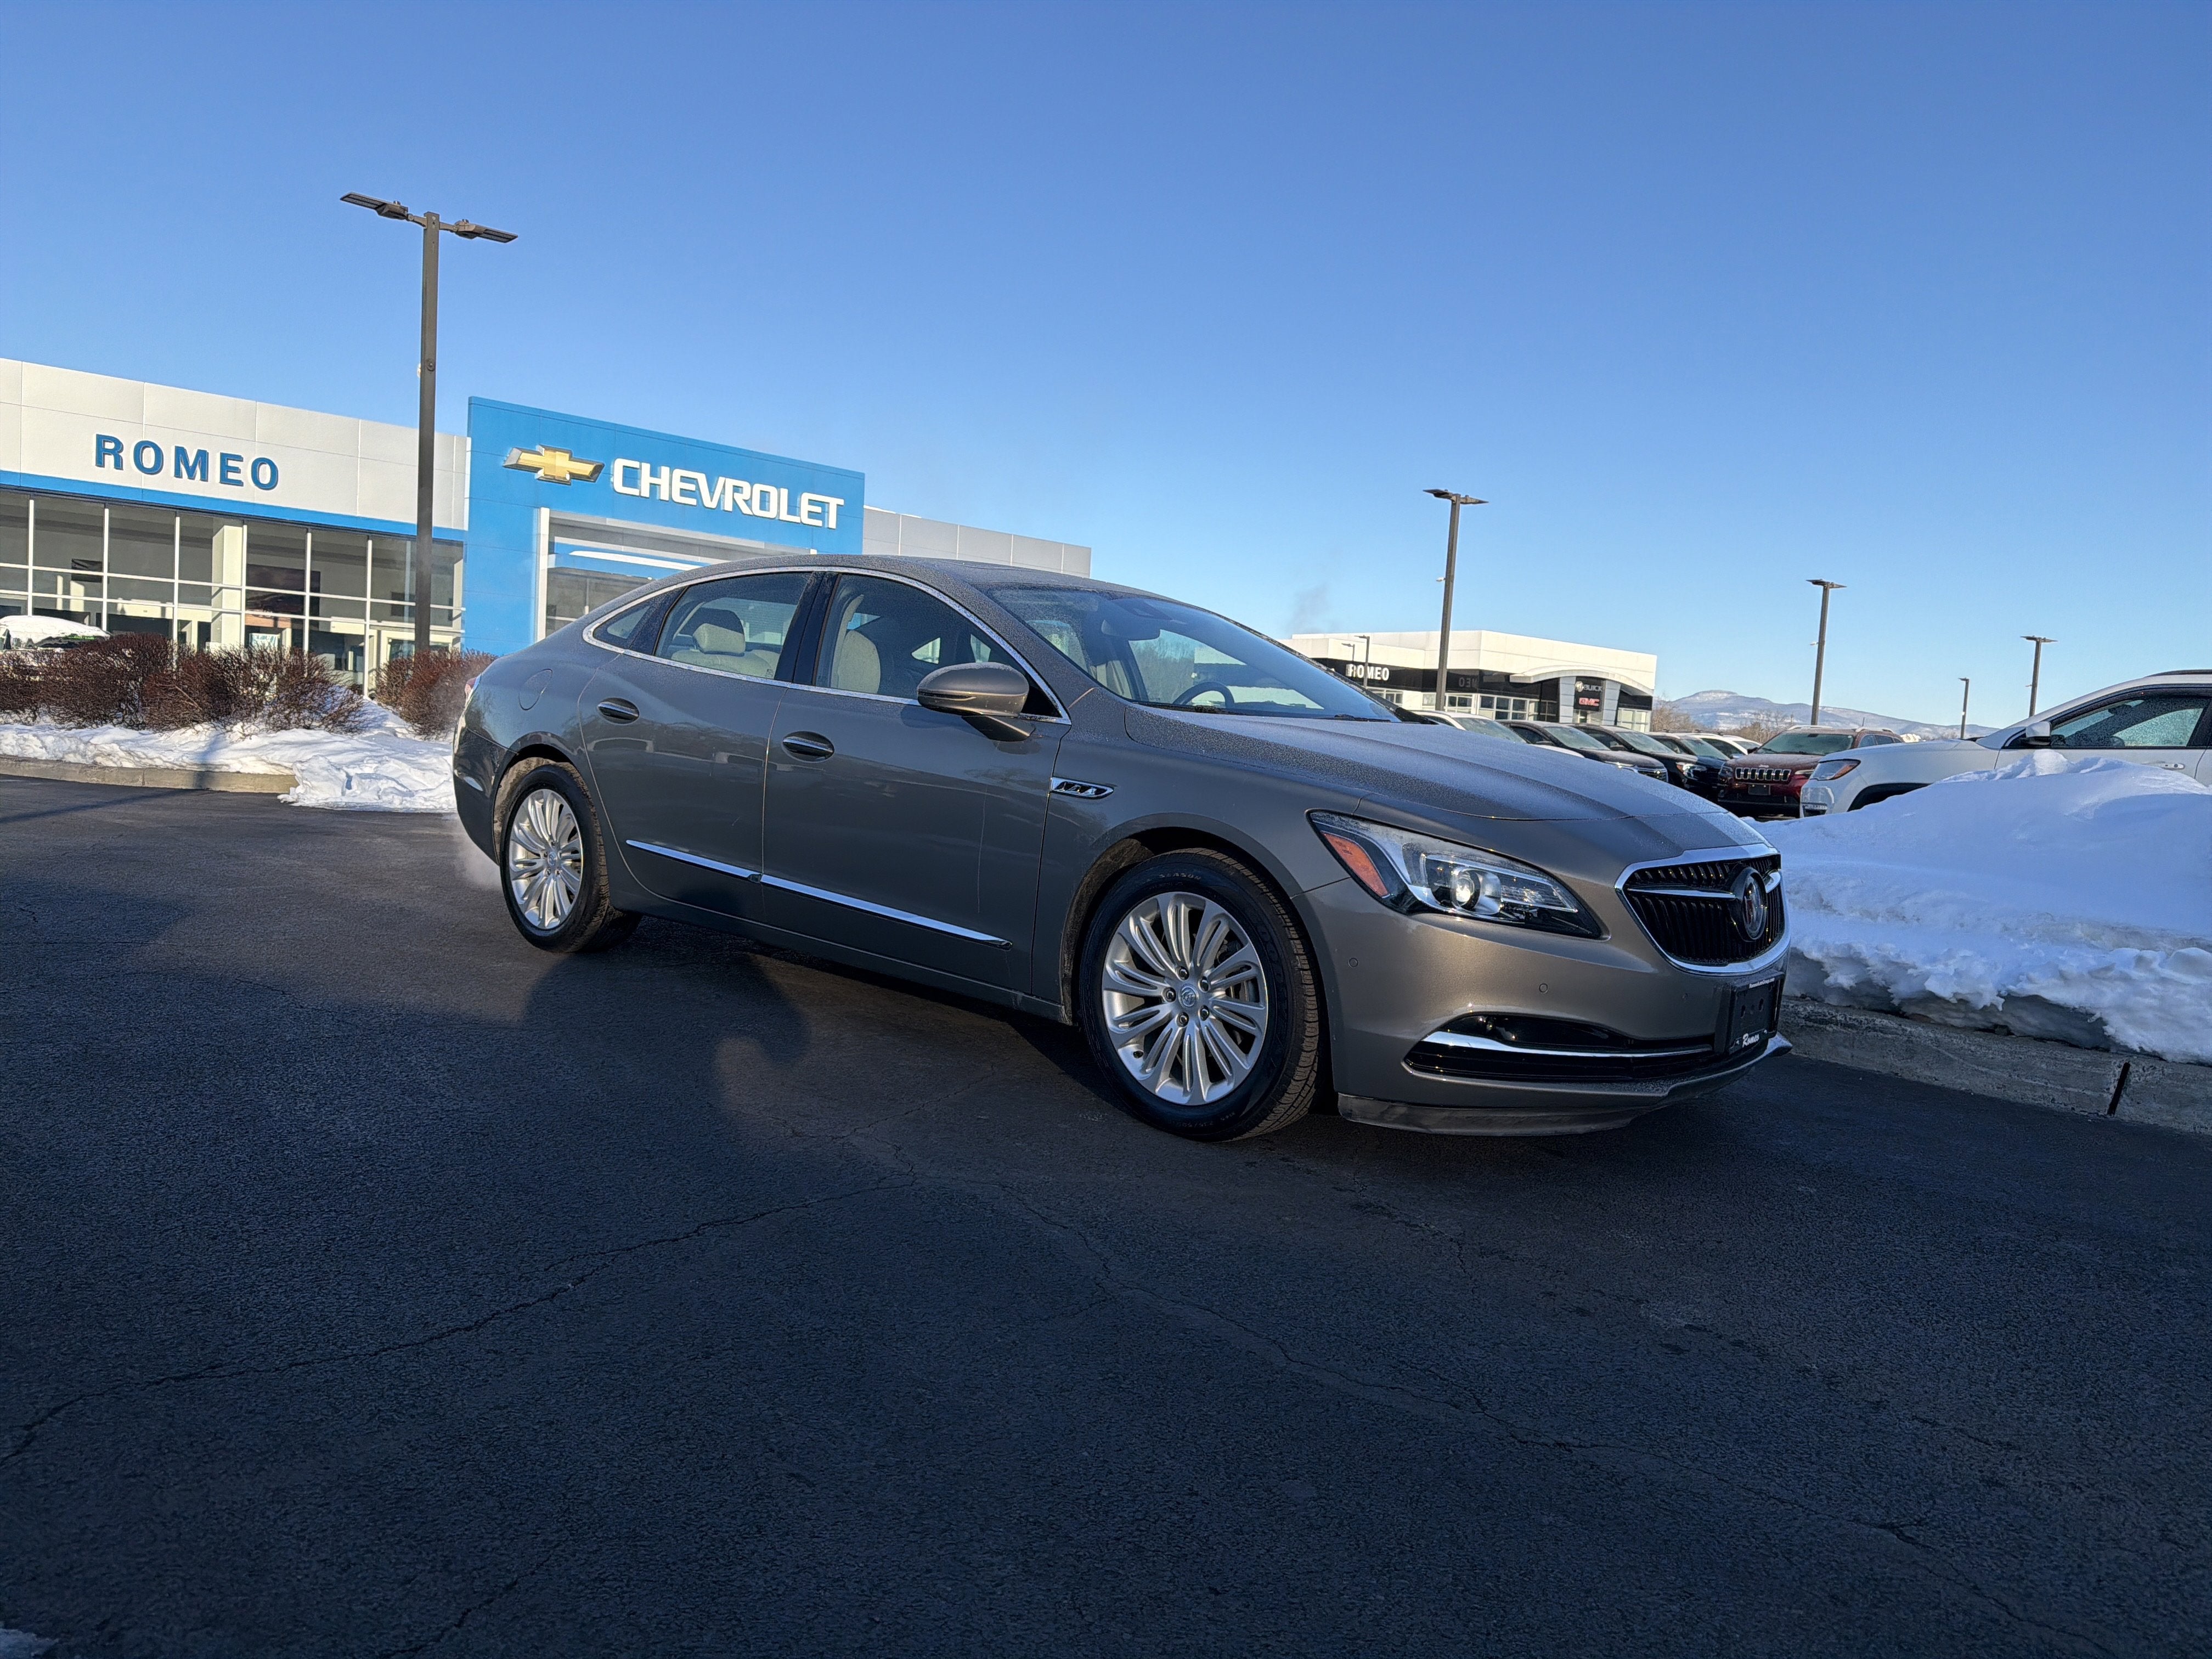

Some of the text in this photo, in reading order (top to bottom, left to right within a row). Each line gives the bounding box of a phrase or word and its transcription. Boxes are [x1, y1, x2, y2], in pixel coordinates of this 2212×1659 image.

[94, 433, 279, 491] ROMEO
[612, 458, 845, 529] CHEVROLET
[1346, 663, 1390, 681] ROMEO
[1578, 697, 1600, 707] GMC
